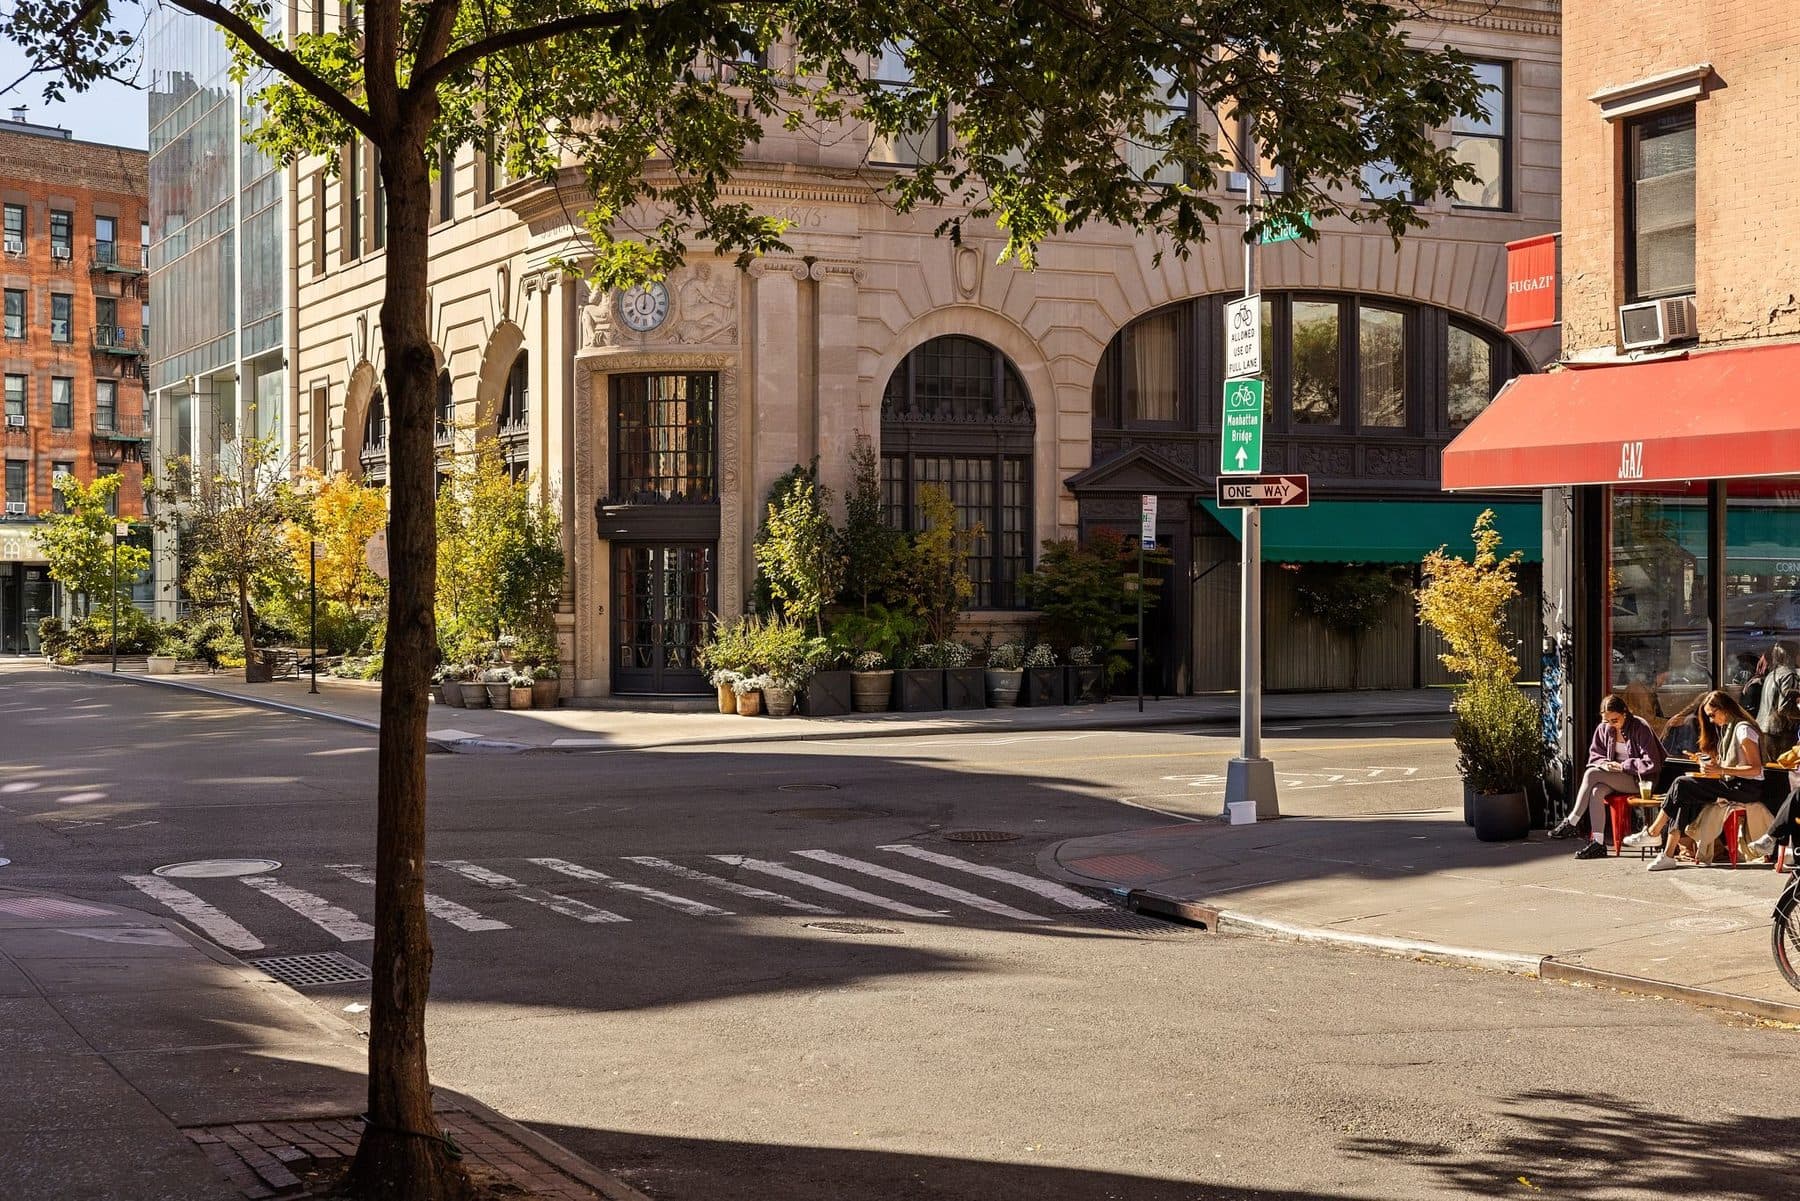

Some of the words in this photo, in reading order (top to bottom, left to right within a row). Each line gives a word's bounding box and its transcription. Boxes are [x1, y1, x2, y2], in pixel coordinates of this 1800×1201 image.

[1231, 328, 1255, 343] ALLOWED
[1233, 345, 1244, 357] USE
[1244, 343, 1253, 354] OF
[1229, 363, 1242, 374] FULL
[1243, 358, 1257, 370] LANE
[1227, 413, 1258, 426] Manhattan
[1231, 429, 1253, 444] Bridge
[1228, 486, 1252, 498] ONE
[1264, 485, 1290, 497] WAY
